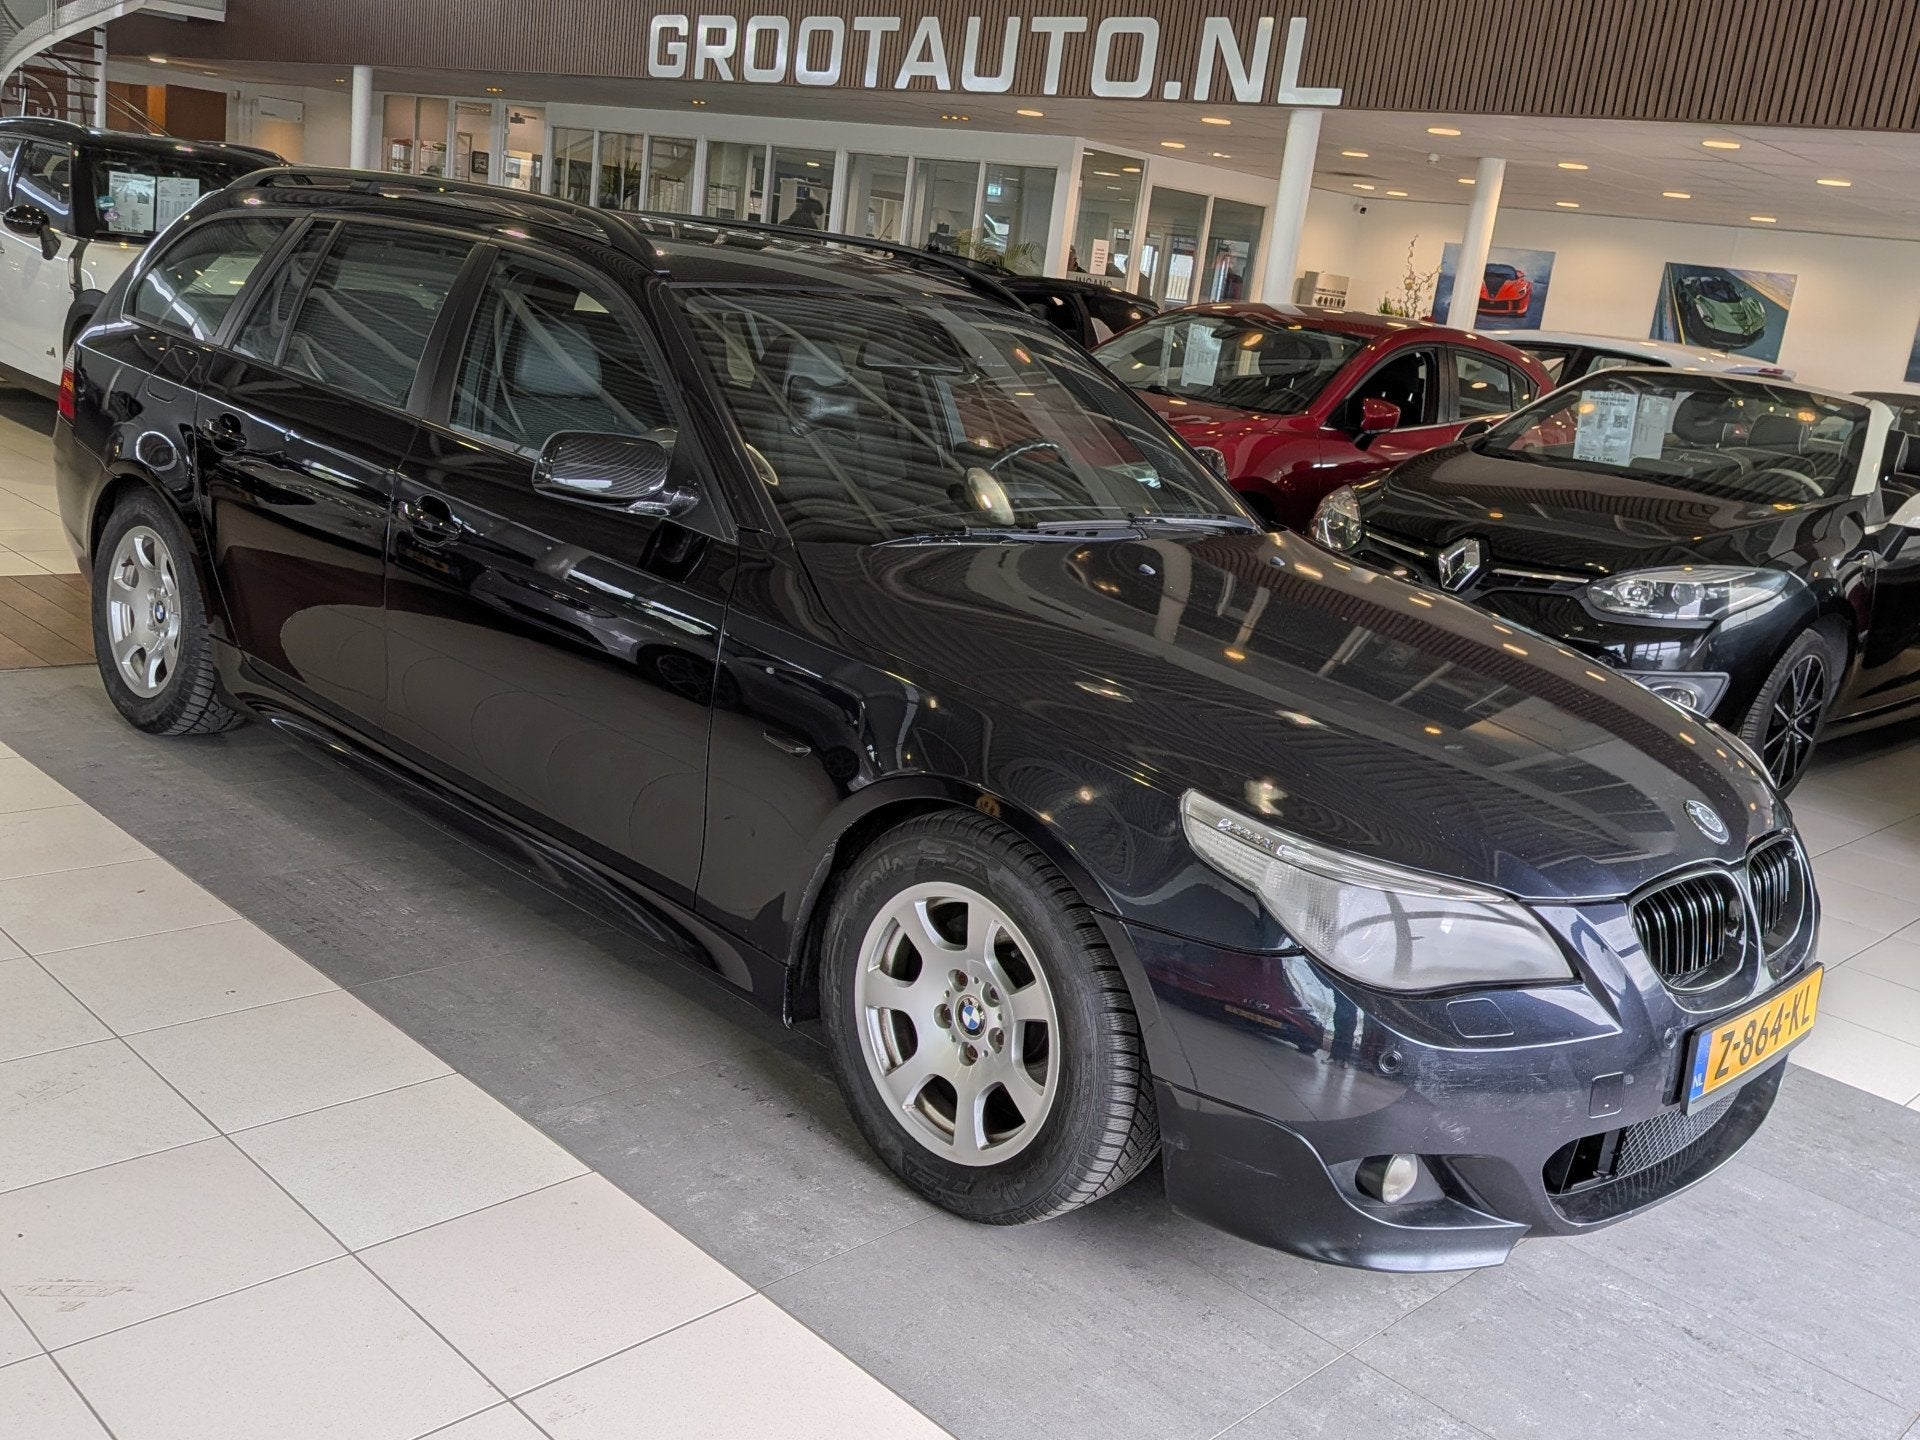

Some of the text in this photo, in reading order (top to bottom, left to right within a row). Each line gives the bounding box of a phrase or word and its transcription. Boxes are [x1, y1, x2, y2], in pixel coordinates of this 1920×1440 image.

[648, 14, 1343, 107] GROOTAUTO.NL
[1714, 983, 1811, 1081] Z-864-KL
[1692, 1075, 1703, 1089] NL
